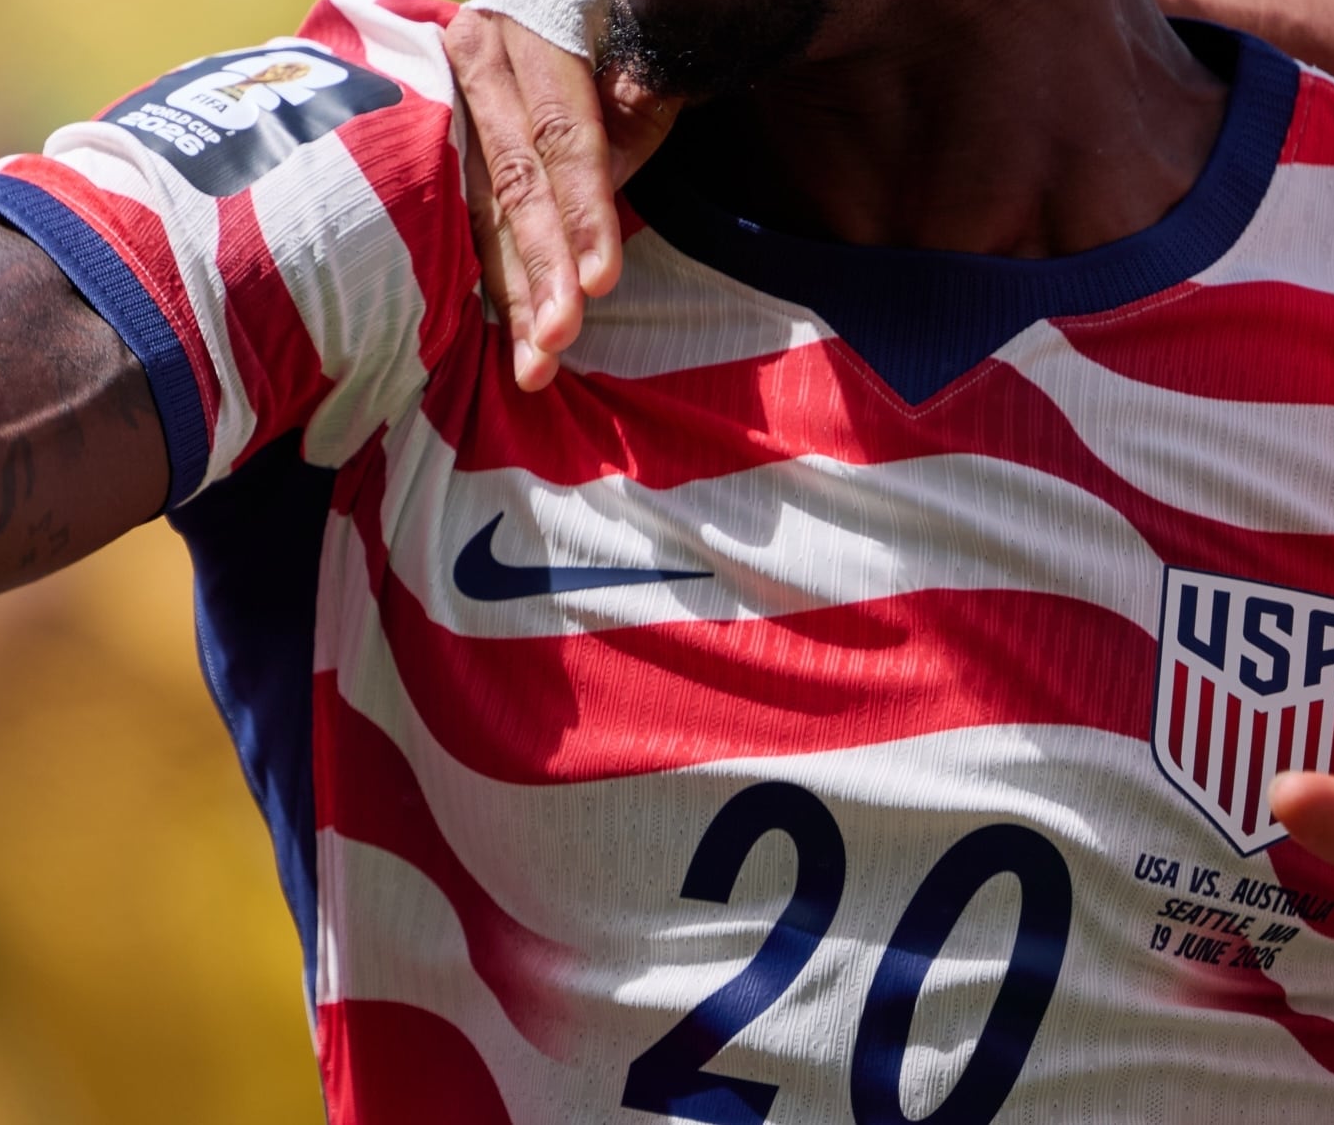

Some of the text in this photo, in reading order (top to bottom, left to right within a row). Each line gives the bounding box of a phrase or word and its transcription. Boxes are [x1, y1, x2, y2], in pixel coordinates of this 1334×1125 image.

[140, 102, 221, 144] WORLD CUP
[190, 93, 228, 113] FIFA
[116, 111, 206, 157] 2026
[1134, 853, 1180, 888] USA
[1188, 866, 1221, 899] VS.
[1157, 898, 1301, 945] SEATTLE, WA
[621, 781, 1073, 1125] 20
[1150, 924, 1282, 971] 19 JUNE 2026
